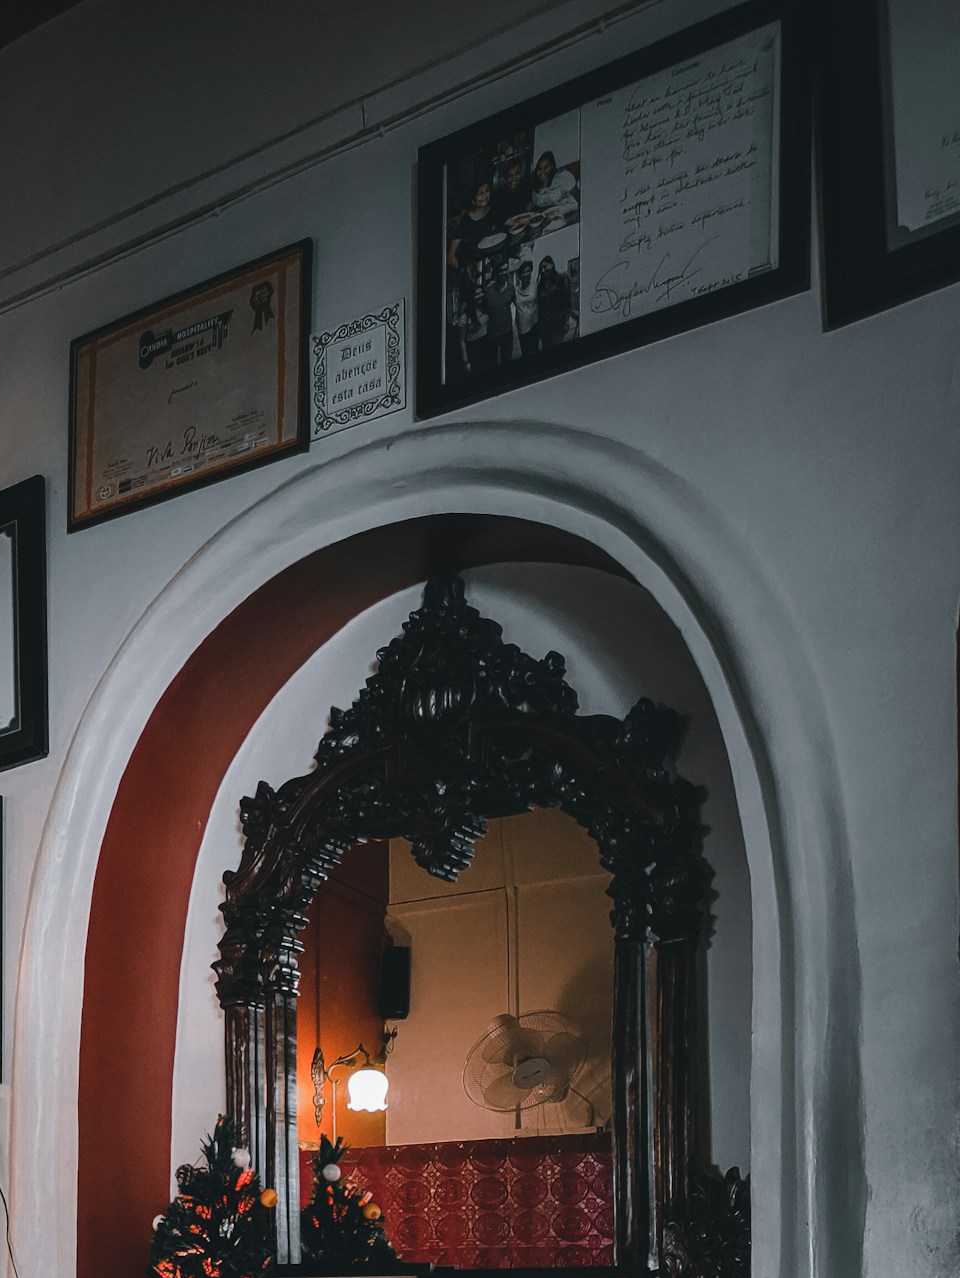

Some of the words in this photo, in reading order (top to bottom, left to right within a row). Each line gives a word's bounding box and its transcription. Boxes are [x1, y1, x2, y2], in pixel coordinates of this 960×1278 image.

[176, 316, 221, 342] HOSPITALITY
[339, 338, 372, 362] Deus
[335, 359, 378, 384] abençoe
[332, 387, 354, 405] esta
[358, 378, 382, 395] casa
